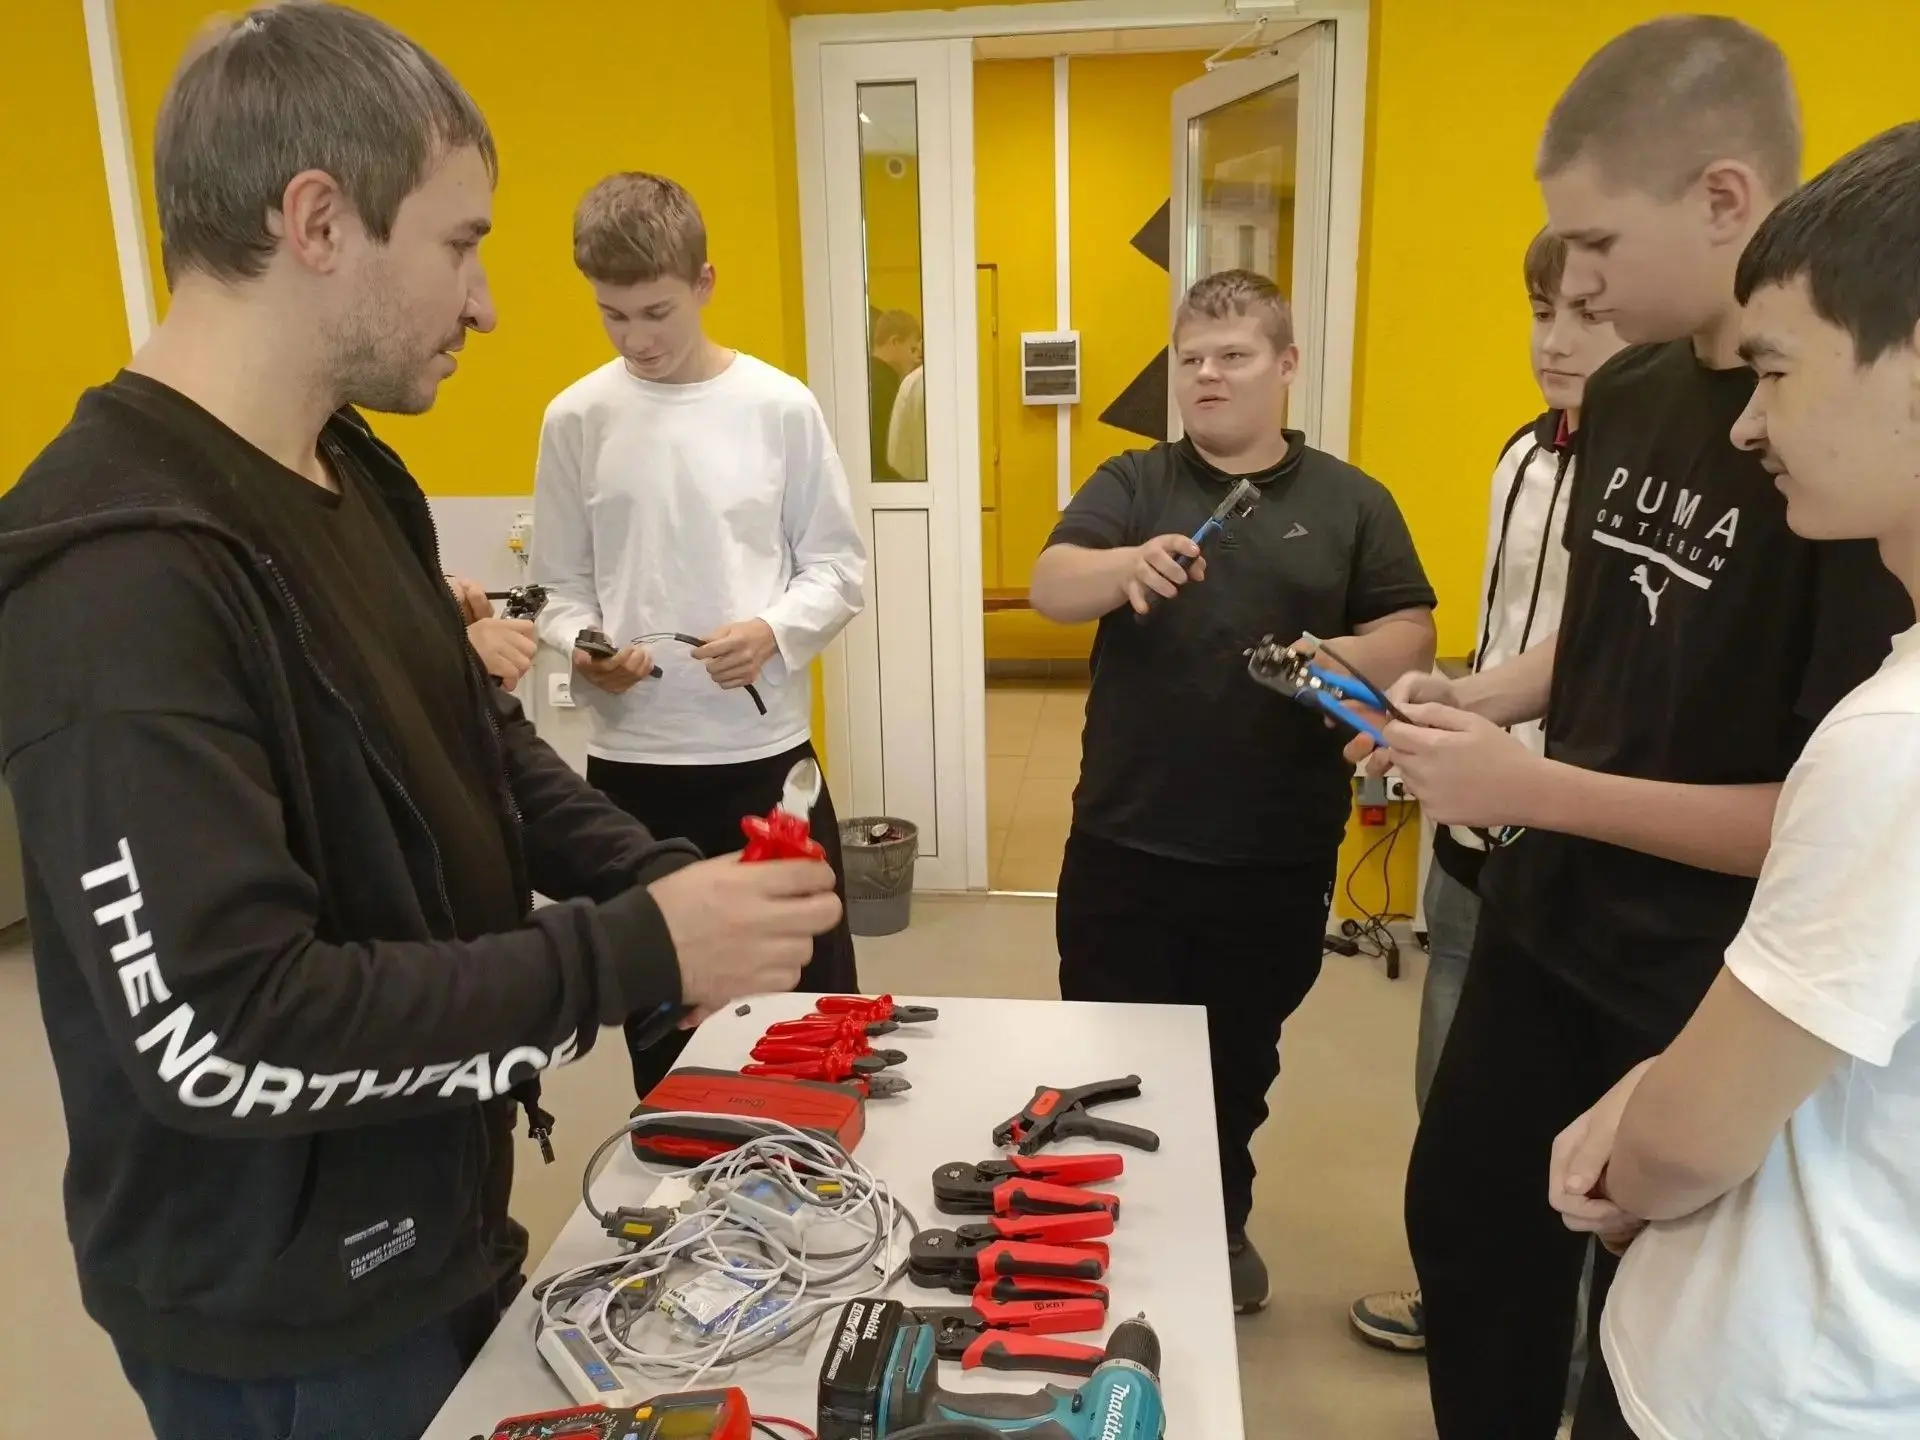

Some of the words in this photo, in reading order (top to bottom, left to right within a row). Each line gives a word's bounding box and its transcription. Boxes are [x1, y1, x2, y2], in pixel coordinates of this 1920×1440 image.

[1596, 508, 1624, 529] ON
[1637, 520, 1675, 547] TE
[1676, 539, 1726, 572] RUN
[1603, 466, 1740, 548] PUMA
[80, 836, 173, 1019] THE
